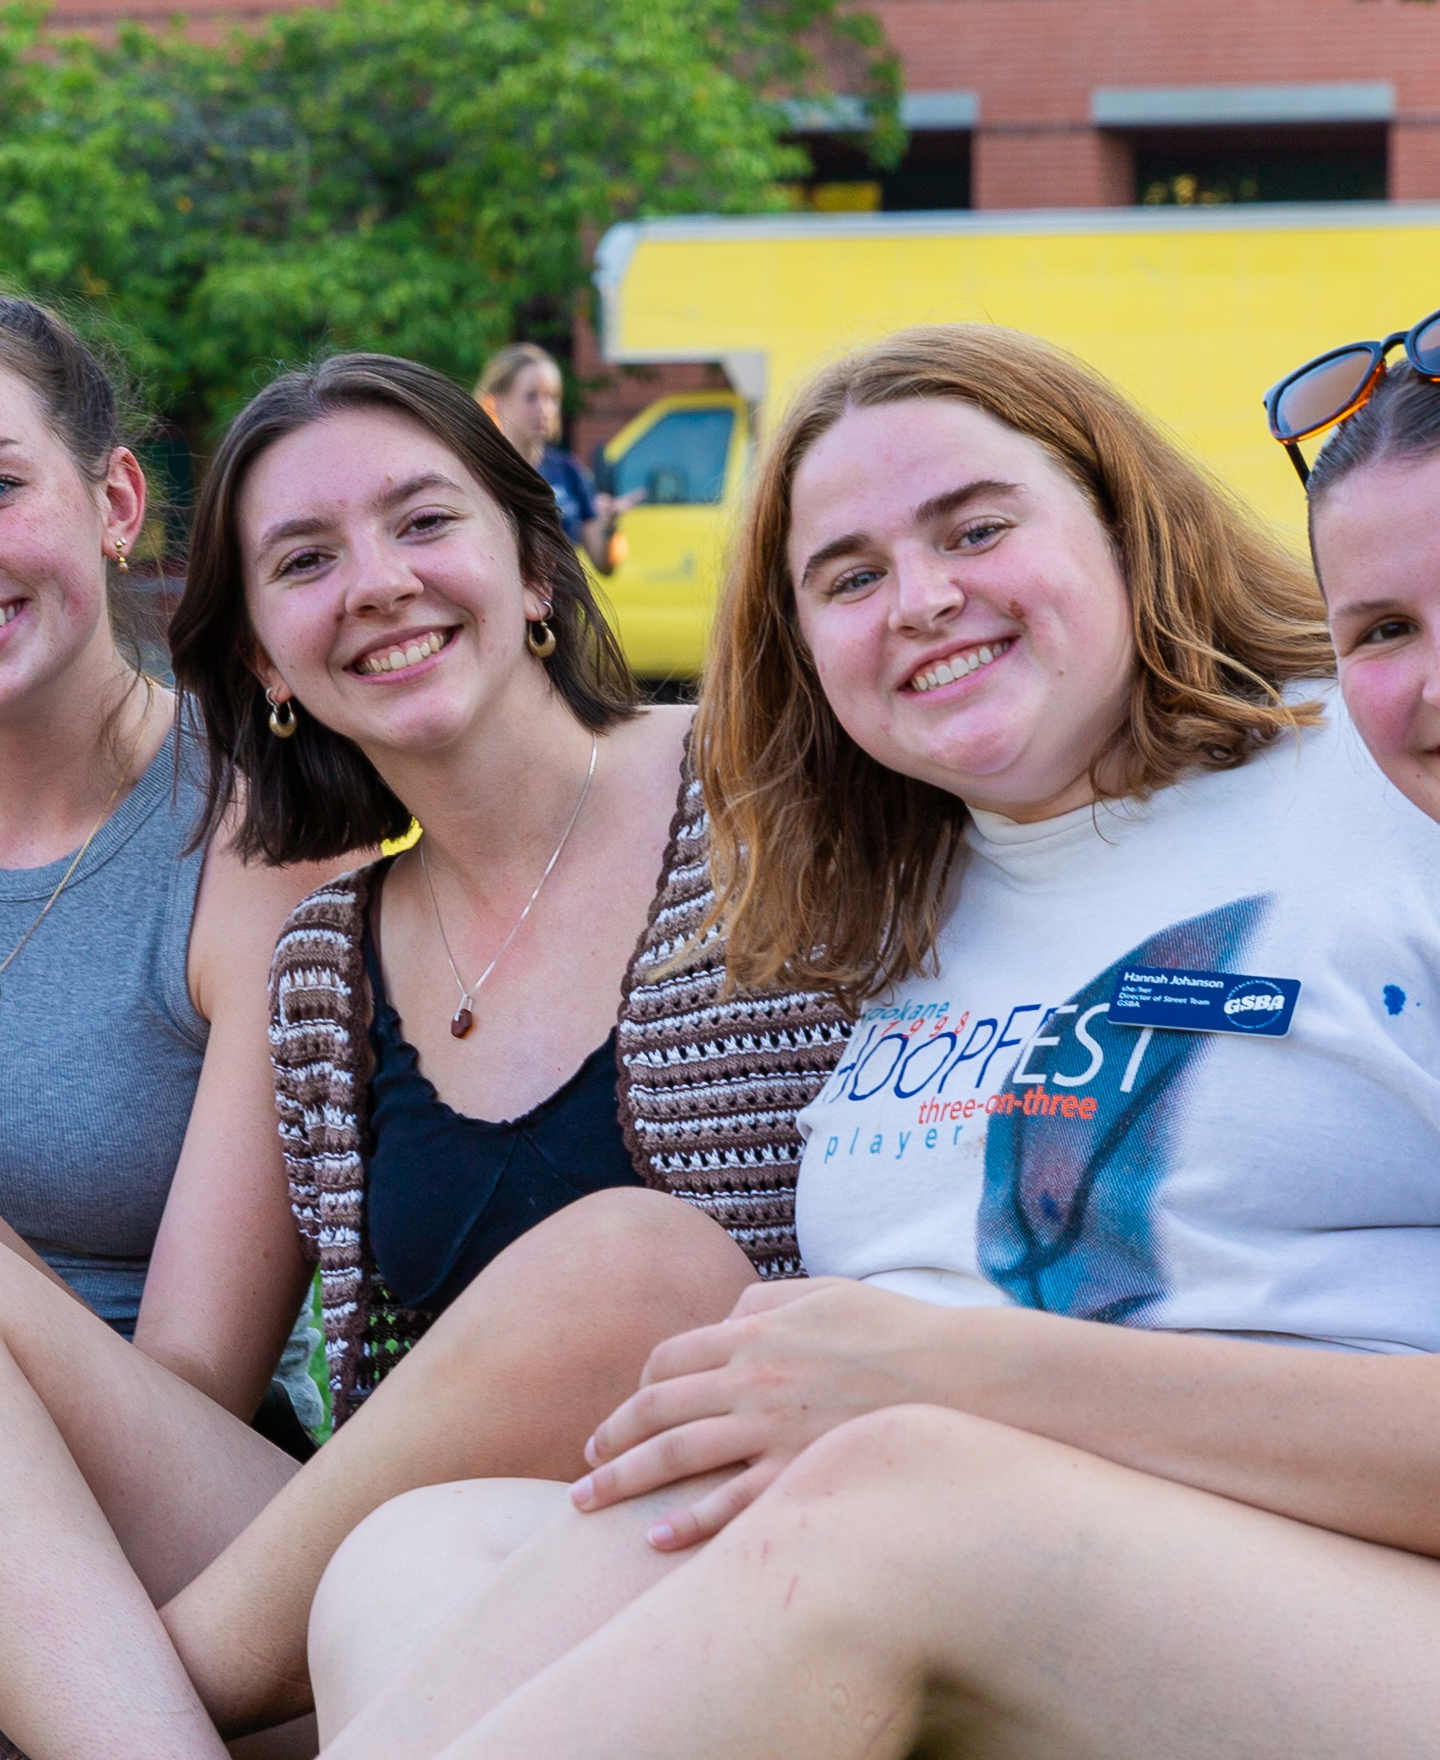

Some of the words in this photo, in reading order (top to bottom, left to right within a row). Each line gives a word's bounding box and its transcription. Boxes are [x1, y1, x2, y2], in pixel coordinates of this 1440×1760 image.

[1123, 971, 1168, 984] Hannah
[1169, 975, 1224, 988] Johanson
[863, 999, 950, 1023] pokane
[1223, 994, 1285, 1014] GSBA
[918, 1085, 1097, 1124] three-on-three
[824, 1124, 963, 1164] player
